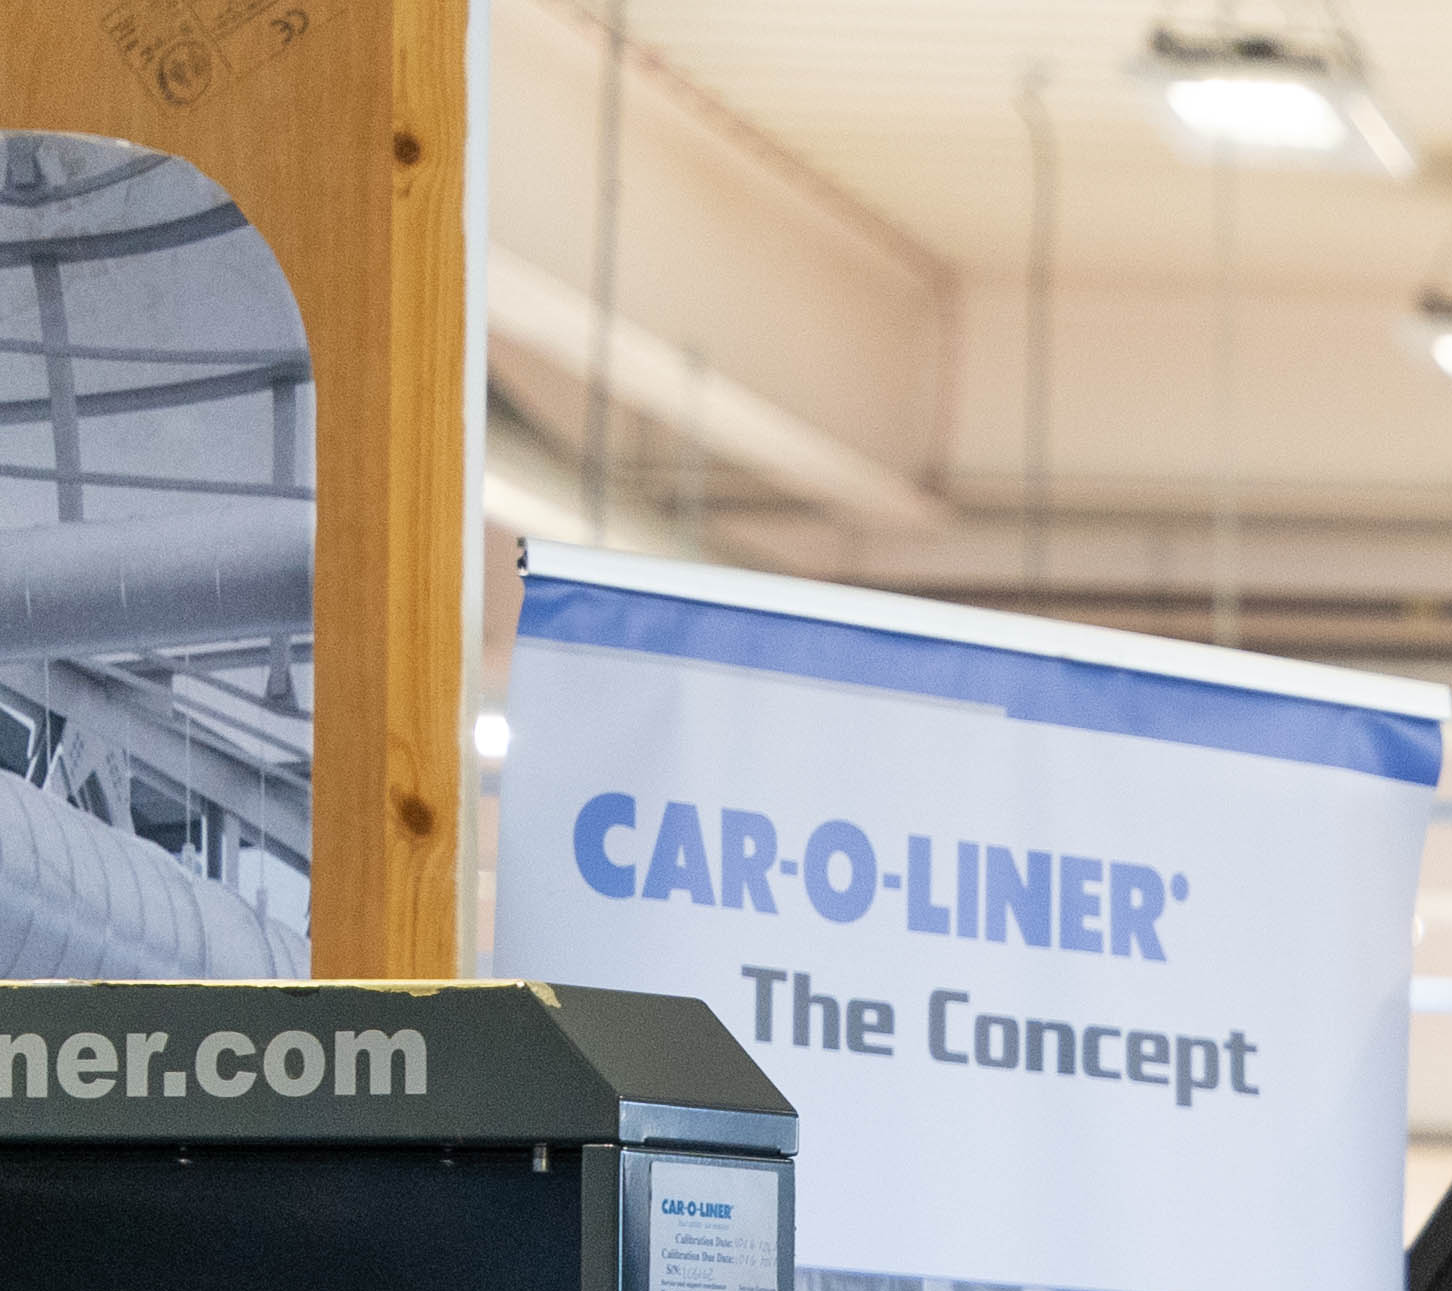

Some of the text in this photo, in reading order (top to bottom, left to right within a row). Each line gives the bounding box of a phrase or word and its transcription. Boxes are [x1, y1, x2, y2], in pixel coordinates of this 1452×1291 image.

[741, 964, 1260, 1108] The Concept
[675, 1233, 714, 1247] Calibration
[661, 1248, 700, 1261] Calibration
